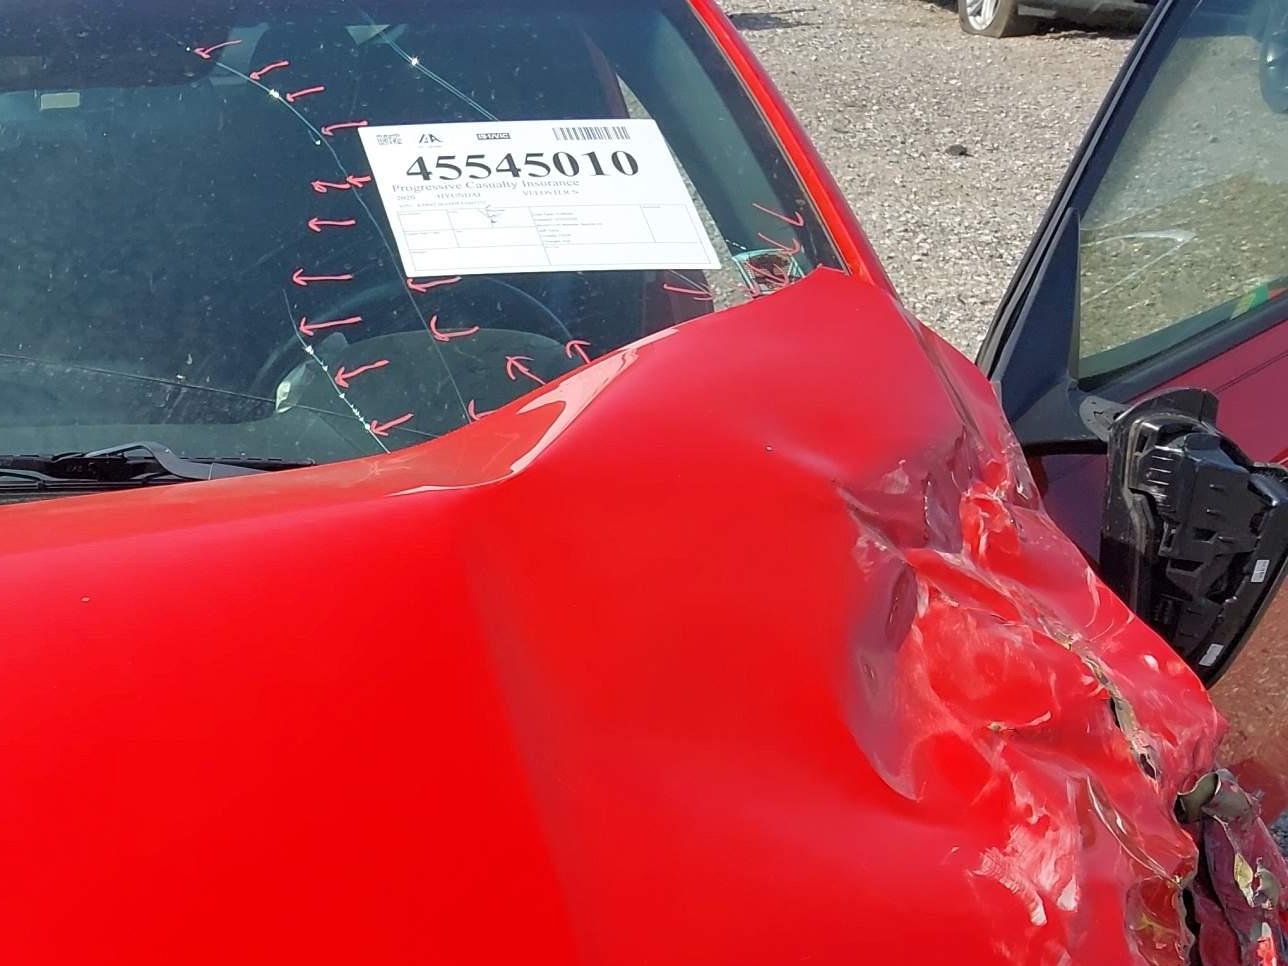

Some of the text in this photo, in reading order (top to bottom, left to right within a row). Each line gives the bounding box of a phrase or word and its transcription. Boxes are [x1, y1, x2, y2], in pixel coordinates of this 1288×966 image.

[406, 150, 639, 181] 45545010
[392, 179, 581, 194] Progressive Casualty Insurance
